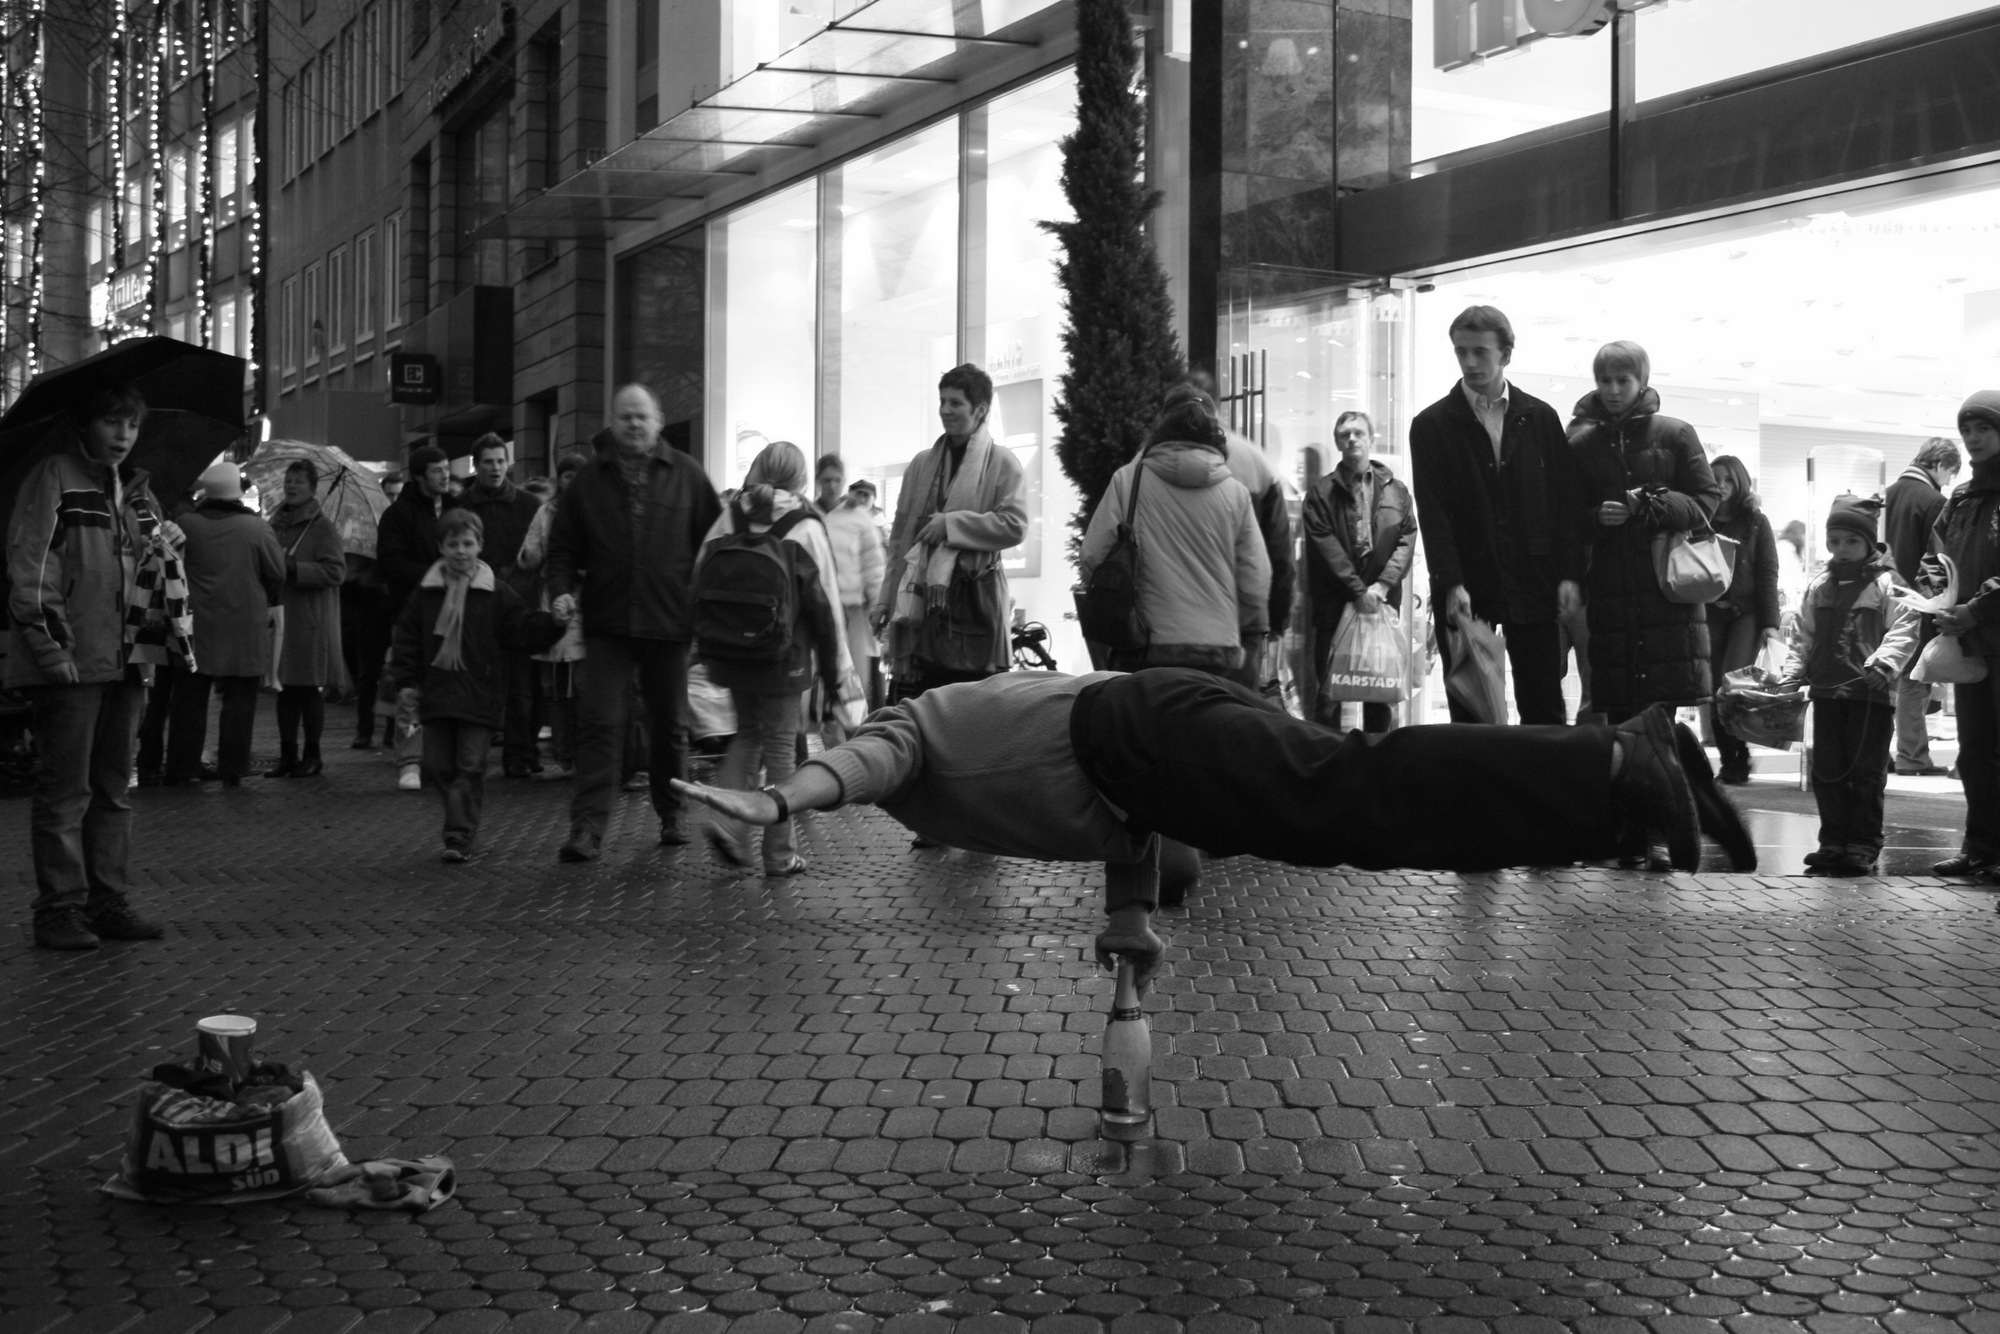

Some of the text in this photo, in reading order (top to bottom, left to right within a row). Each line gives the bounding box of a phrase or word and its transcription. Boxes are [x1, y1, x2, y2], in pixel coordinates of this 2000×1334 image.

[1331, 674, 1402, 688] KARSTADT
[146, 1127, 274, 1173] ALDI
[232, 1167, 280, 1191] SÜD
